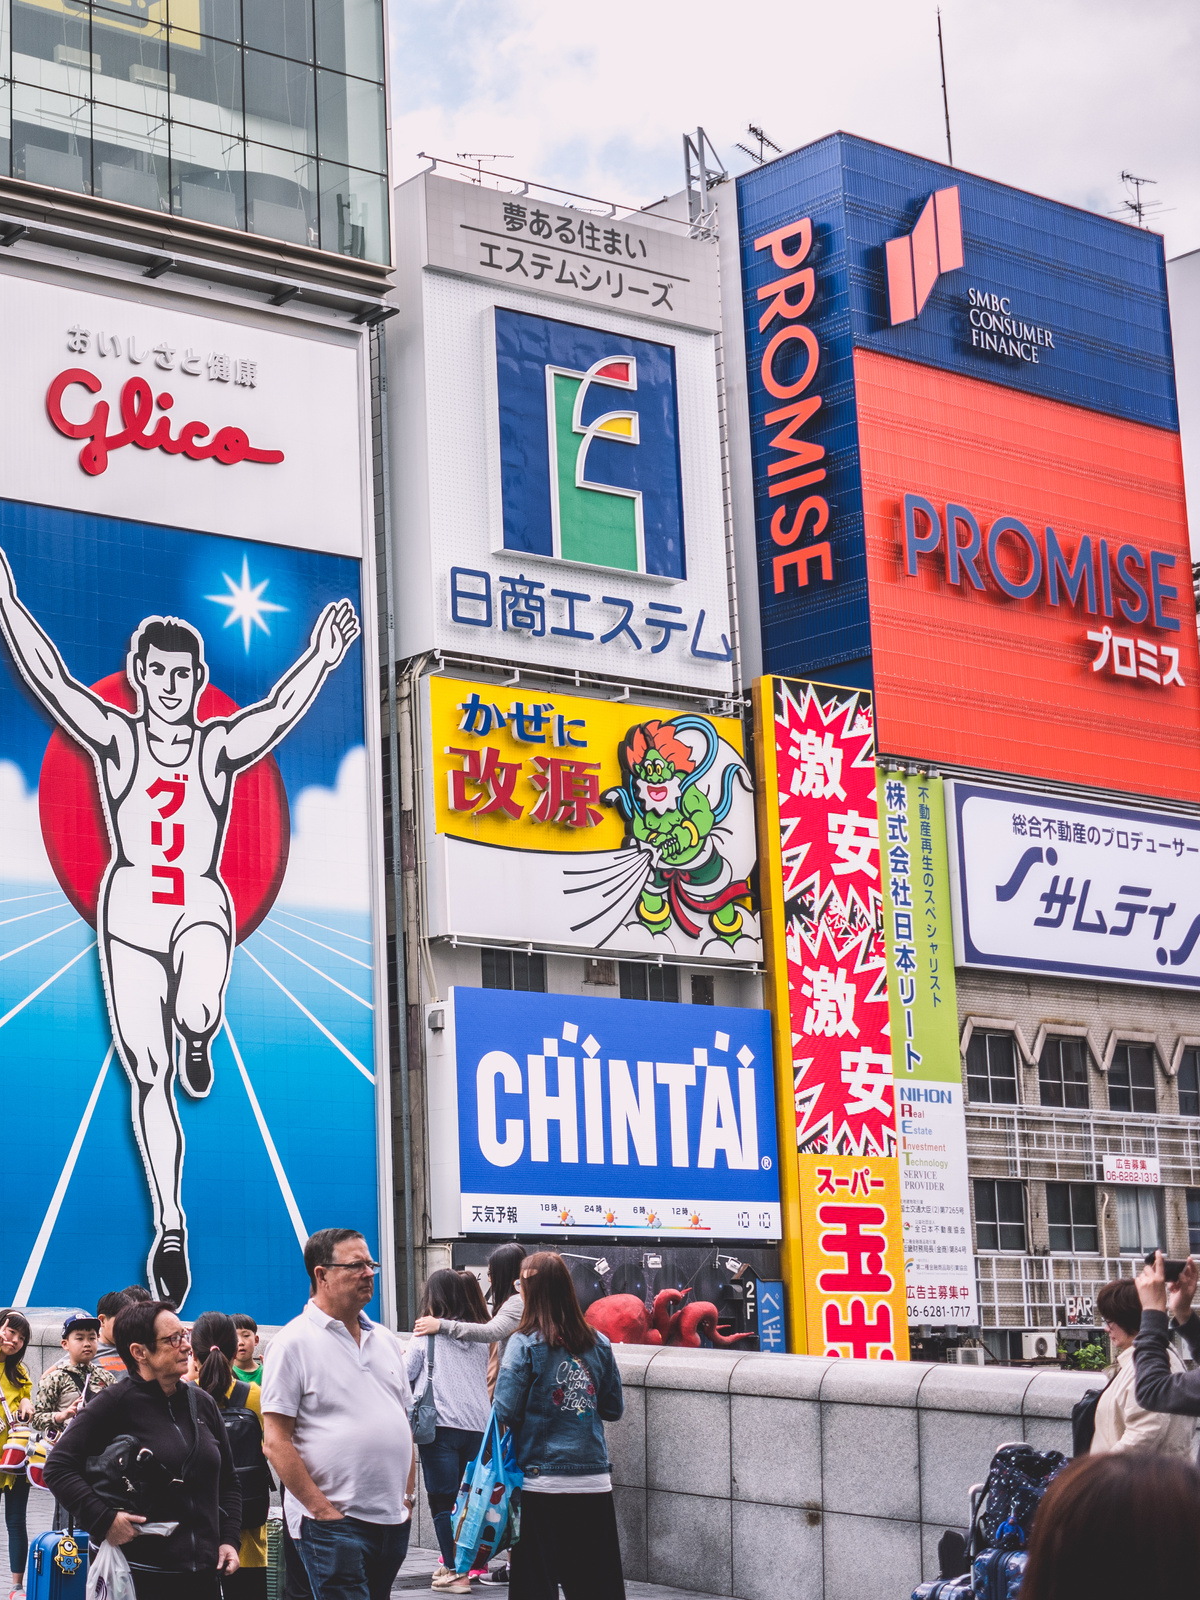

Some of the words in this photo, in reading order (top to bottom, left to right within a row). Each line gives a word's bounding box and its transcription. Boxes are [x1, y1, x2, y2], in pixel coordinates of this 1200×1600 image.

[502, 201, 647, 260] 夢ある住まい
[480, 241, 674, 312] エステムシリーズ
[968, 287, 1011, 317] SMBC
[969, 308, 1056, 350] CONSUMER
[971, 328, 1040, 364] FINANCE
[67, 324, 258, 388] おいしさと健康
[47, 368, 285, 475] Glico
[754, 216, 834, 595] PROMISE
[903, 493, 1182, 632] PROMISE
[450, 566, 734, 662] 日商エステム
[1085, 625, 1186, 688] プロミス
[456, 692, 589, 748] かぜに
[444, 745, 605, 829] 改源
[145, 773, 188, 906] グリコ
[1012, 812, 1199, 857] 総合不動産のプロデューサー
[917, 786, 942, 1009] 不動産再生のスペシャリスト
[1033, 874, 1177, 941] サムティ
[885, 780, 921, 1072] 株式会社日本リート
[476, 1034, 760, 1171] CHINTAI
[900, 1087, 952, 1104] NIHON
[901, 1103, 925, 1119] Real
[901, 1120, 933, 1136] Estate
[902, 1136, 946, 1152] Investment
[902, 1152, 949, 1169] Technology
[903, 1169, 938, 1180] SERVICE
[1106, 1170, 1159, 1183] 06-6262-1313
[1115, 1158, 1148, 1171] 広告募集
[815, 1167, 886, 1197] スーパー
[904, 1180, 945, 1191] PROVIDER
[471, 1205, 519, 1224] 天気予報
[540, 1203, 558, 1213] 18時
[584, 1204, 602, 1214] 24時
[632, 1205, 646, 1215] 6時
[671, 1207, 689, 1217] 12時
[745, 1281, 756, 1320] 2F
[905, 1285, 969, 1300] 広告主募集中
[906, 1304, 971, 1319] 06-6281-1717
[1066, 1297, 1092, 1316] BAR
[761, 1292, 783, 1352] ペンギ
